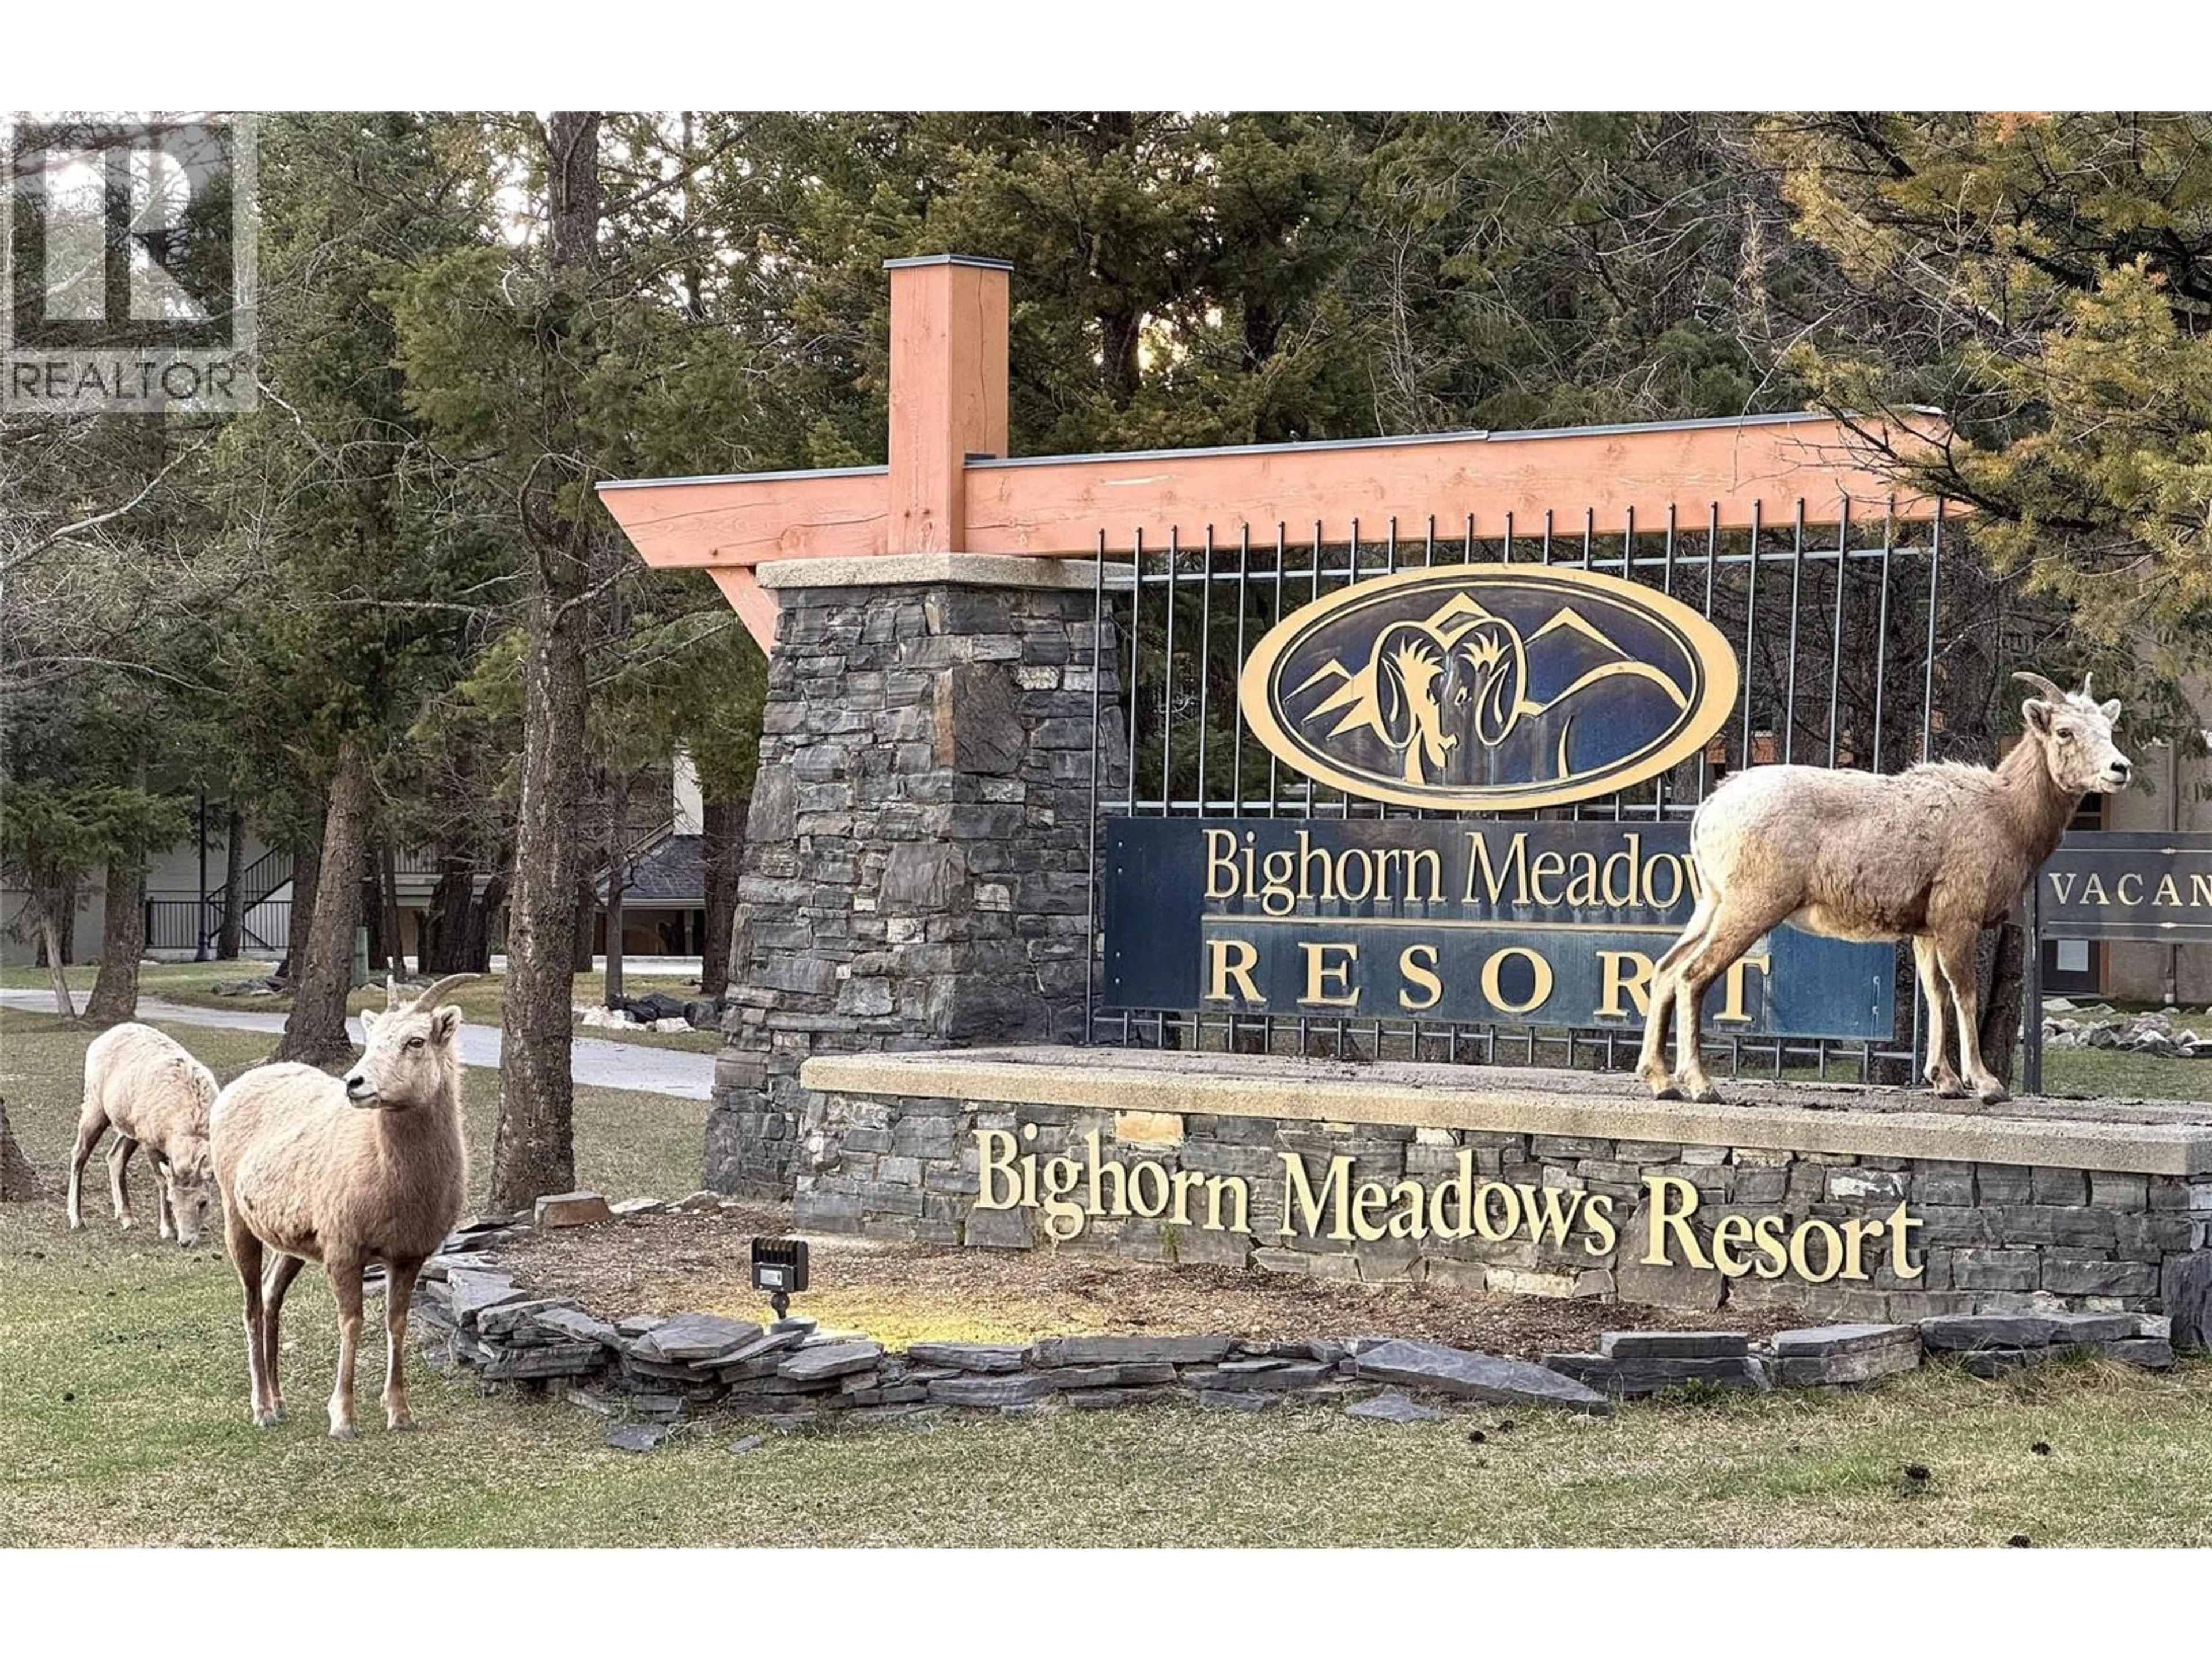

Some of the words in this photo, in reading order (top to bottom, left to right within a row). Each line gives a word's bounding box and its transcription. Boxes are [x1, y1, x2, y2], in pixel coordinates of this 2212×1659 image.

[1202, 829, 1447, 916] Bighorn
[1204, 940, 1770, 1022] RESORT
[974, 1123, 1250, 1240] Bighorn
[1279, 1151, 1616, 1256] Meadows
[1642, 1175, 1925, 1283] Resort
